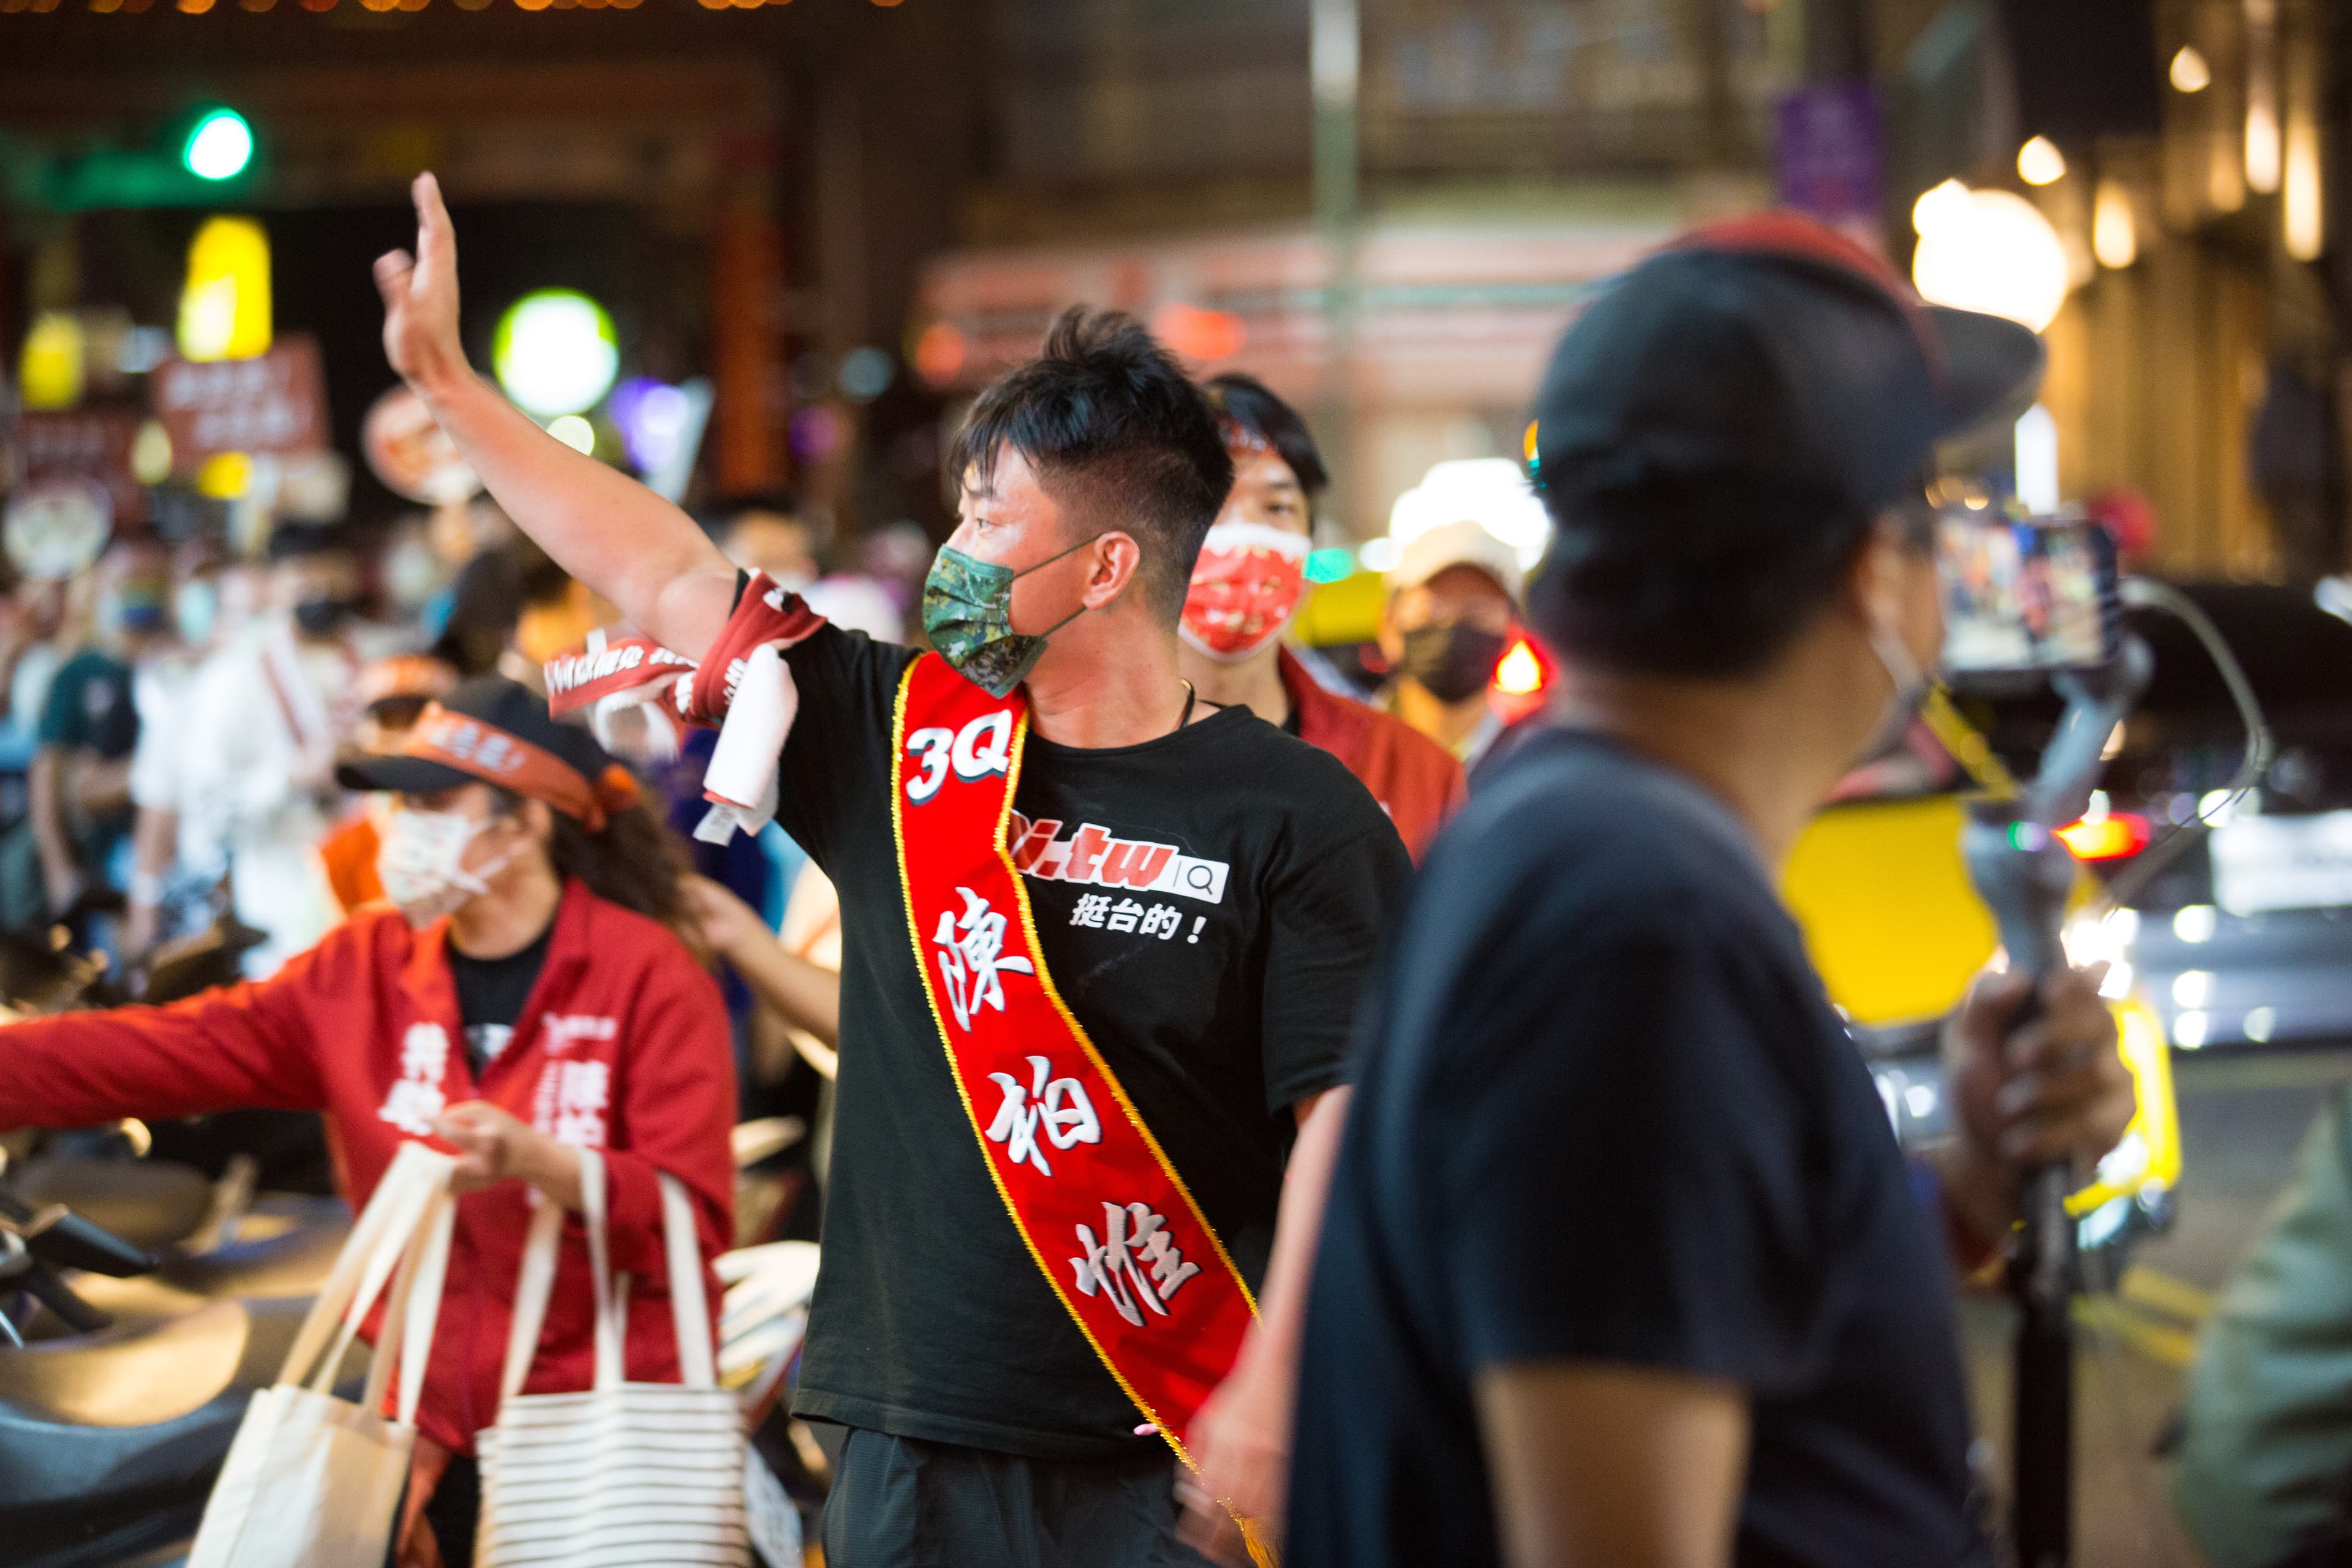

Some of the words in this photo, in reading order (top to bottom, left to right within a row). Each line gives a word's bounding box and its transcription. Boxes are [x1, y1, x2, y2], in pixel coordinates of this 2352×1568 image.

[906, 709, 1012, 805] 3Q
[933, 886, 1200, 1327] 陳柏惟
